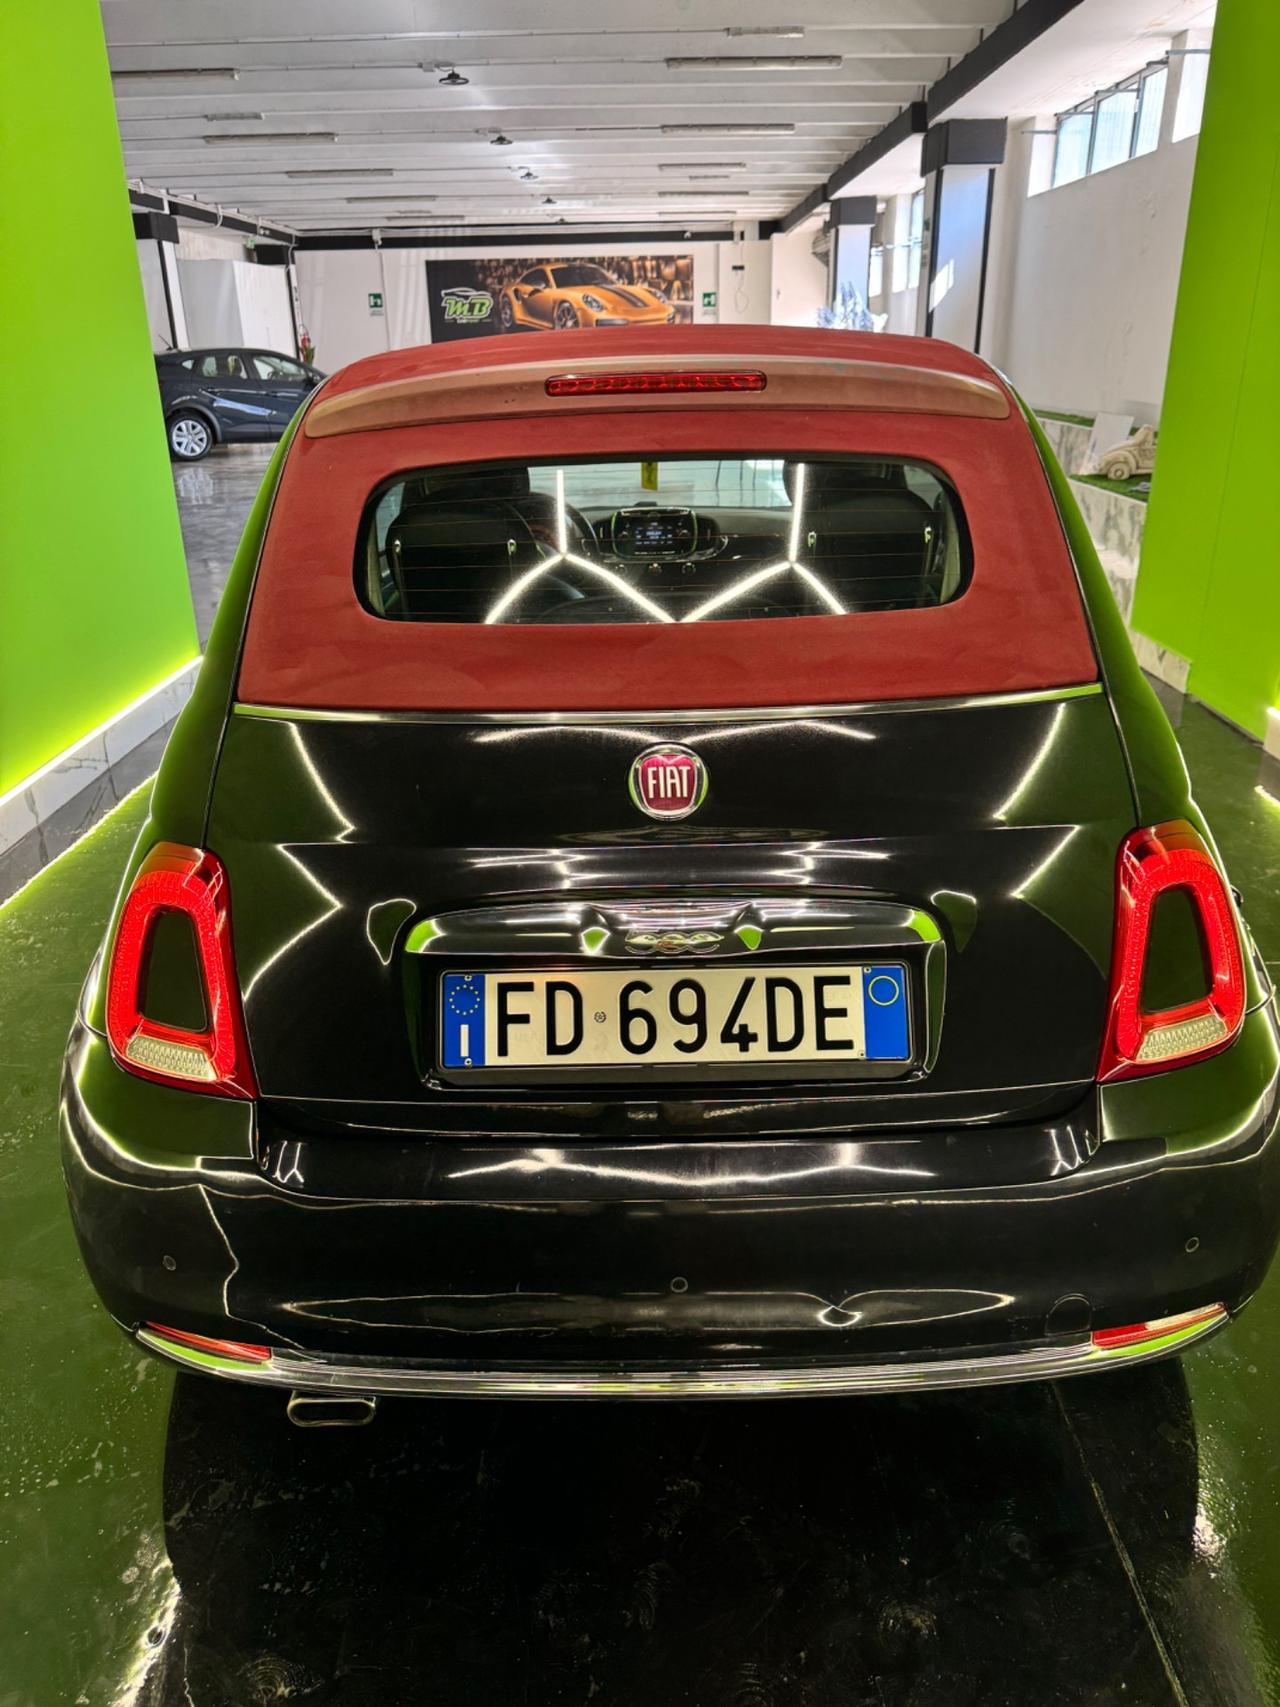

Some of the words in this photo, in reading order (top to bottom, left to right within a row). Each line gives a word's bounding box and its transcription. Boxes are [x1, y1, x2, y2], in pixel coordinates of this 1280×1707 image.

[647, 765, 691, 799] FIAT
[497, 980, 584, 1057] FD
[618, 975, 854, 1056] 694DE
